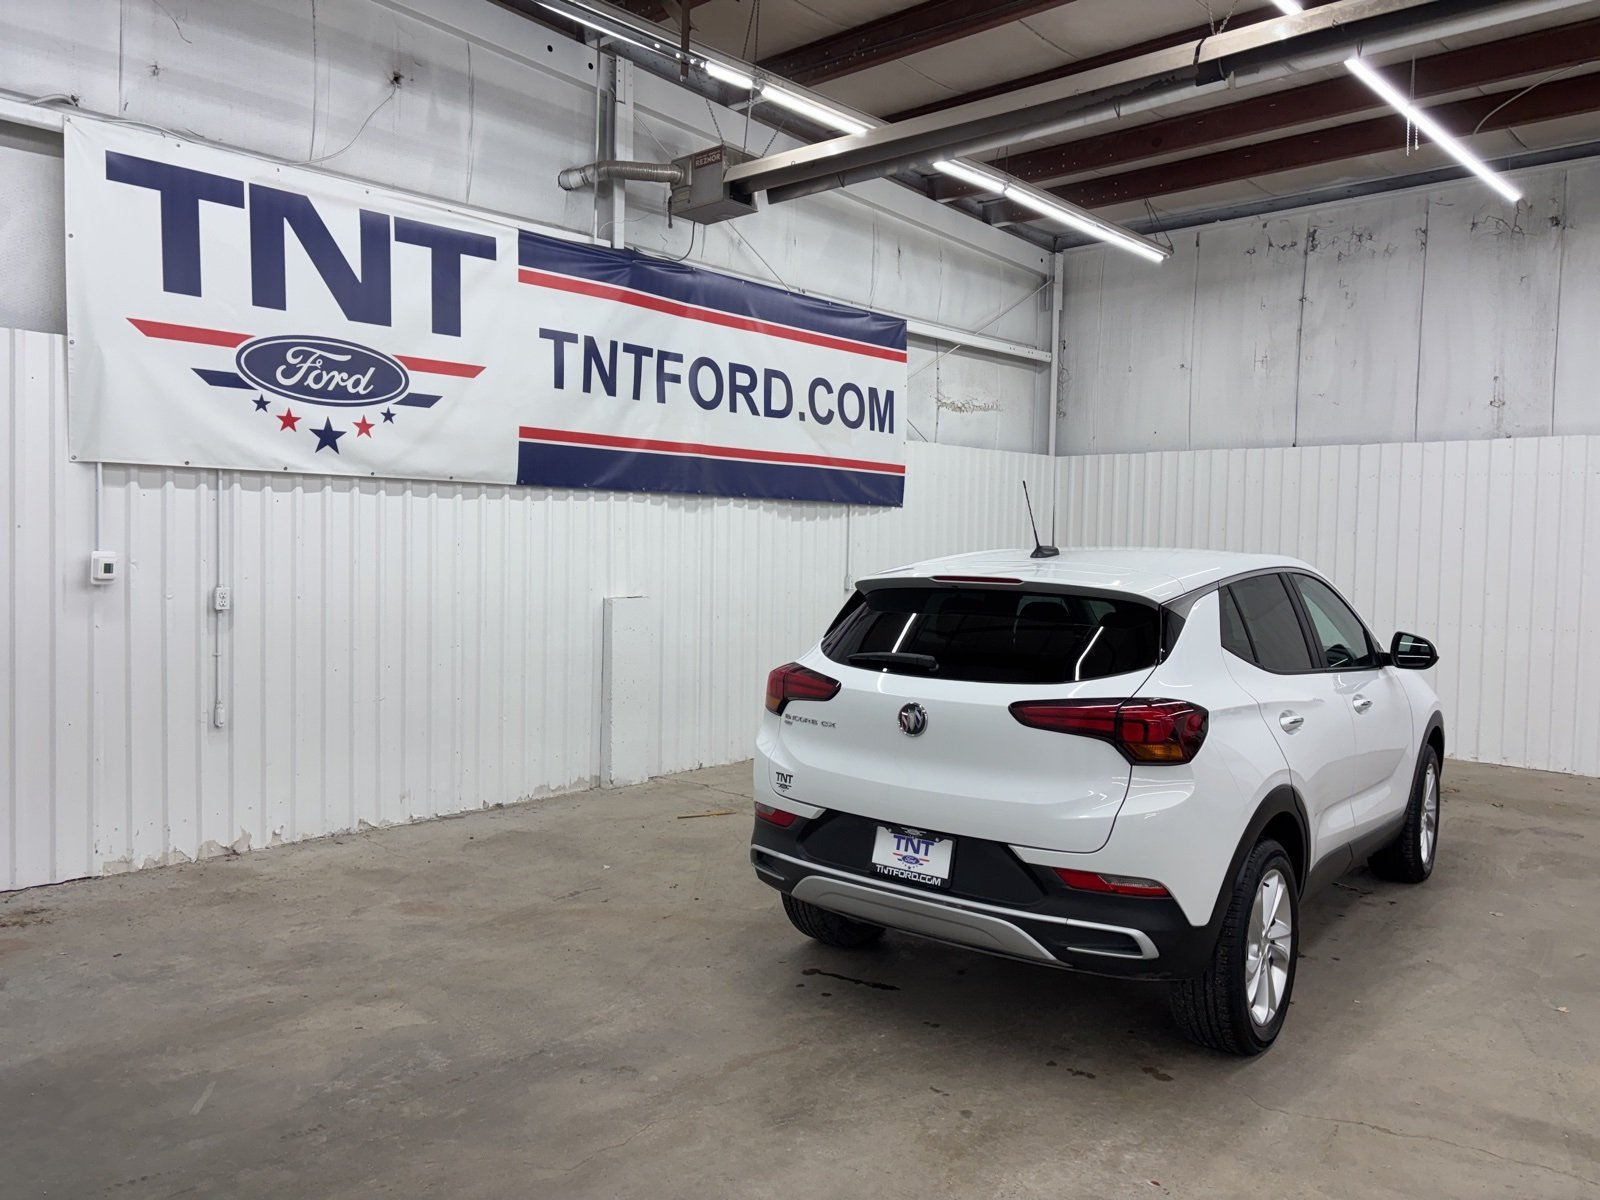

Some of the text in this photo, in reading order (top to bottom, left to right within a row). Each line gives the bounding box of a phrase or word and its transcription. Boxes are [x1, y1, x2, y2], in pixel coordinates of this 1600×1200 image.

[105, 149, 497, 338] TNT
[275, 346, 376, 396] Ford
[538, 327, 895, 434] TNTFORD.COM
[775, 771, 794, 784] TNT
[893, 834, 935, 857] TNT
[876, 864, 942, 887] TNTFORD.COM
